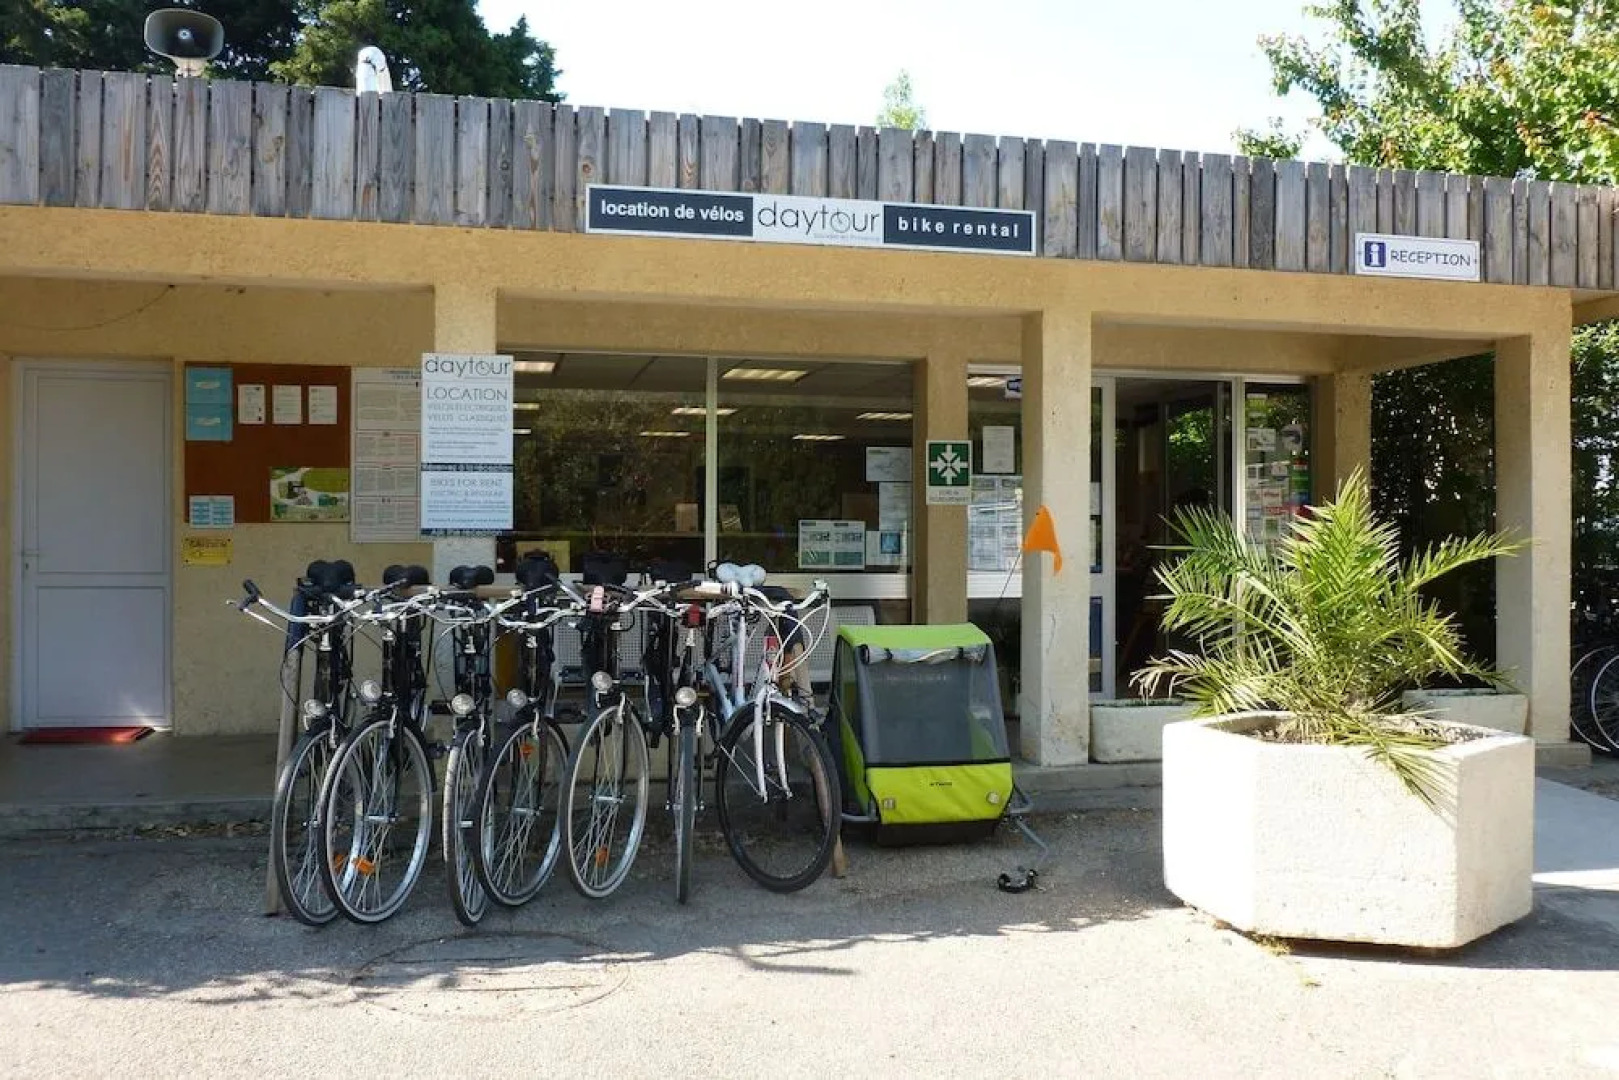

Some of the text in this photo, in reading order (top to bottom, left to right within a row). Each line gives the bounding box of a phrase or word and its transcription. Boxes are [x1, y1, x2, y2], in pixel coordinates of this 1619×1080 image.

[601, 199, 745, 222] location de vélos
[757, 200, 880, 236] daytour
[898, 216, 1019, 239] bike rental
[1390, 249, 1471, 267] RECEPTION
[425, 355, 511, 378] daytour
[427, 386, 508, 401] LOCATION
